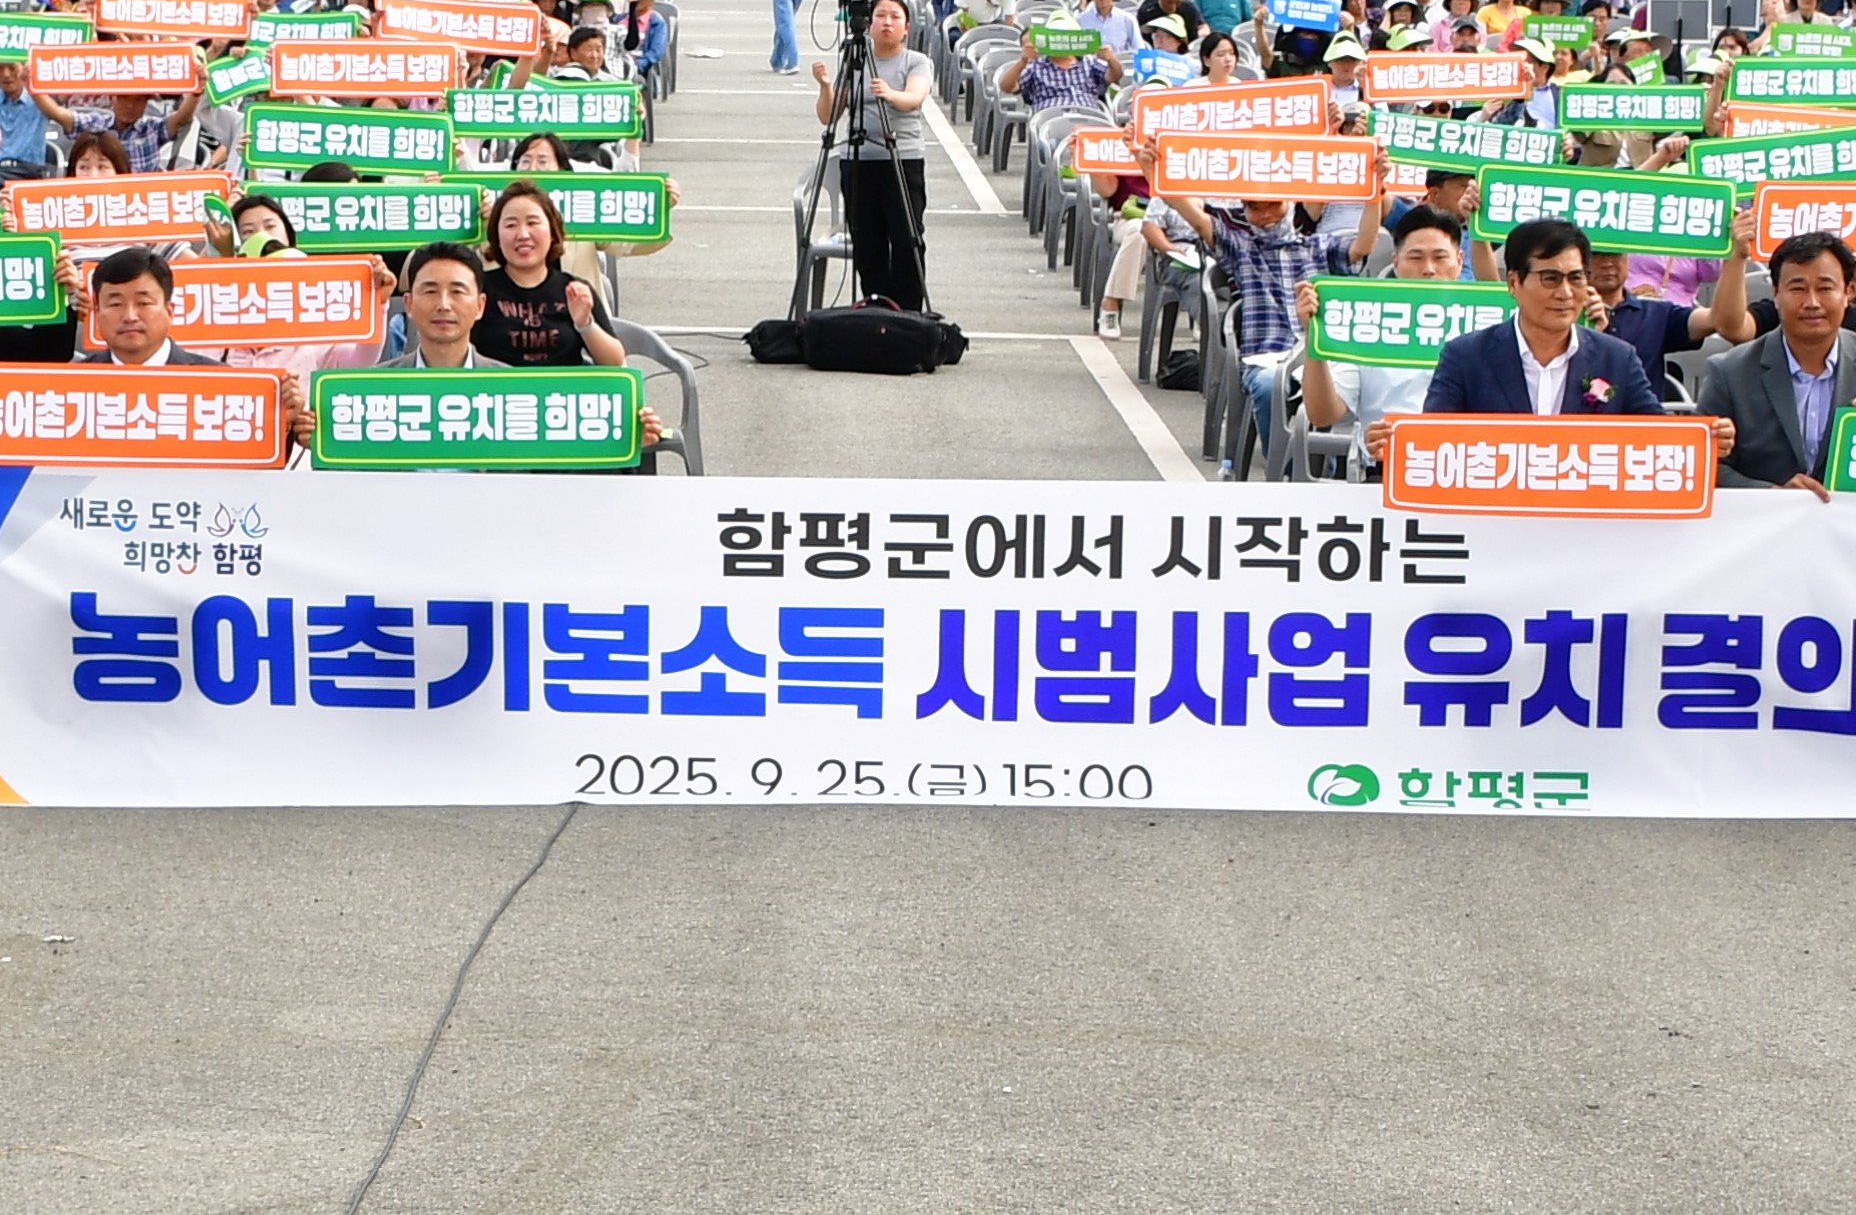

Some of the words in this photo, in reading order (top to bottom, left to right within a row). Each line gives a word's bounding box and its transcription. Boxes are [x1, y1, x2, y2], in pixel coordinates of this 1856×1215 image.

[208, 2, 244, 27] 보장!
[496, 15, 534, 43] 보장!
[36, 55, 150, 81] 농어촌기본소득
[151, 55, 190, 80] 보장!
[280, 53, 406, 82] 농어촌기본소득
[407, 54, 449, 82] 보장!
[1373, 62, 1481, 89] 농어촌기본소득
[1483, 61, 1518, 87] 보장!
[1736, 70, 1785, 95] 함평군
[1790, 69, 1834, 95] 유치를
[454, 93, 518, 122] 함평군
[518, 93, 578, 122] 유치를
[583, 94, 630, 122] 희망!
[1274, 94, 1319, 126] 보장!
[257, 120, 321, 154] 함평군
[325, 124, 390, 157] 유치를
[394, 127, 444, 160] 희망!
[1166, 146, 1314, 183] 농어촌기본소득
[1316, 152, 1366, 185] 보장!
[1702, 145, 1767, 183] 함평군
[1769, 143, 1833, 179] 유치를
[21, 191, 165, 229] 농어촌기본소득
[335, 195, 409, 230] 유치를
[414, 195, 470, 229] 희망!
[597, 190, 654, 224] 희망!
[1488, 182, 1570, 223] 함평군
[1574, 190, 1656, 232] 유치를
[1659, 195, 1723, 236] 희망!
[298, 281, 361, 322] 보장!
[1325, 300, 1411, 344] 함평군
[193, 394, 264, 441] 보장!
[332, 394, 431, 440] 함평군
[438, 393, 537, 440] 유치를
[545, 393, 621, 440] 희망!
[1405, 442, 1618, 490] 농어촌기본소득
[1624, 445, 1695, 491] 보장!
[59, 498, 139, 532] 새로운
[148, 500, 201, 533] 도약
[123, 540, 201, 575] 희망찬
[212, 542, 264, 576] 함평
[718, 506, 1123, 583] 함평군에서
[1153, 512, 1472, 585] 시작하는
[69, 591, 885, 722] 농어촌기본소득
[917, 606, 1372, 731] 시범사업
[1404, 609, 1624, 731] 유치
